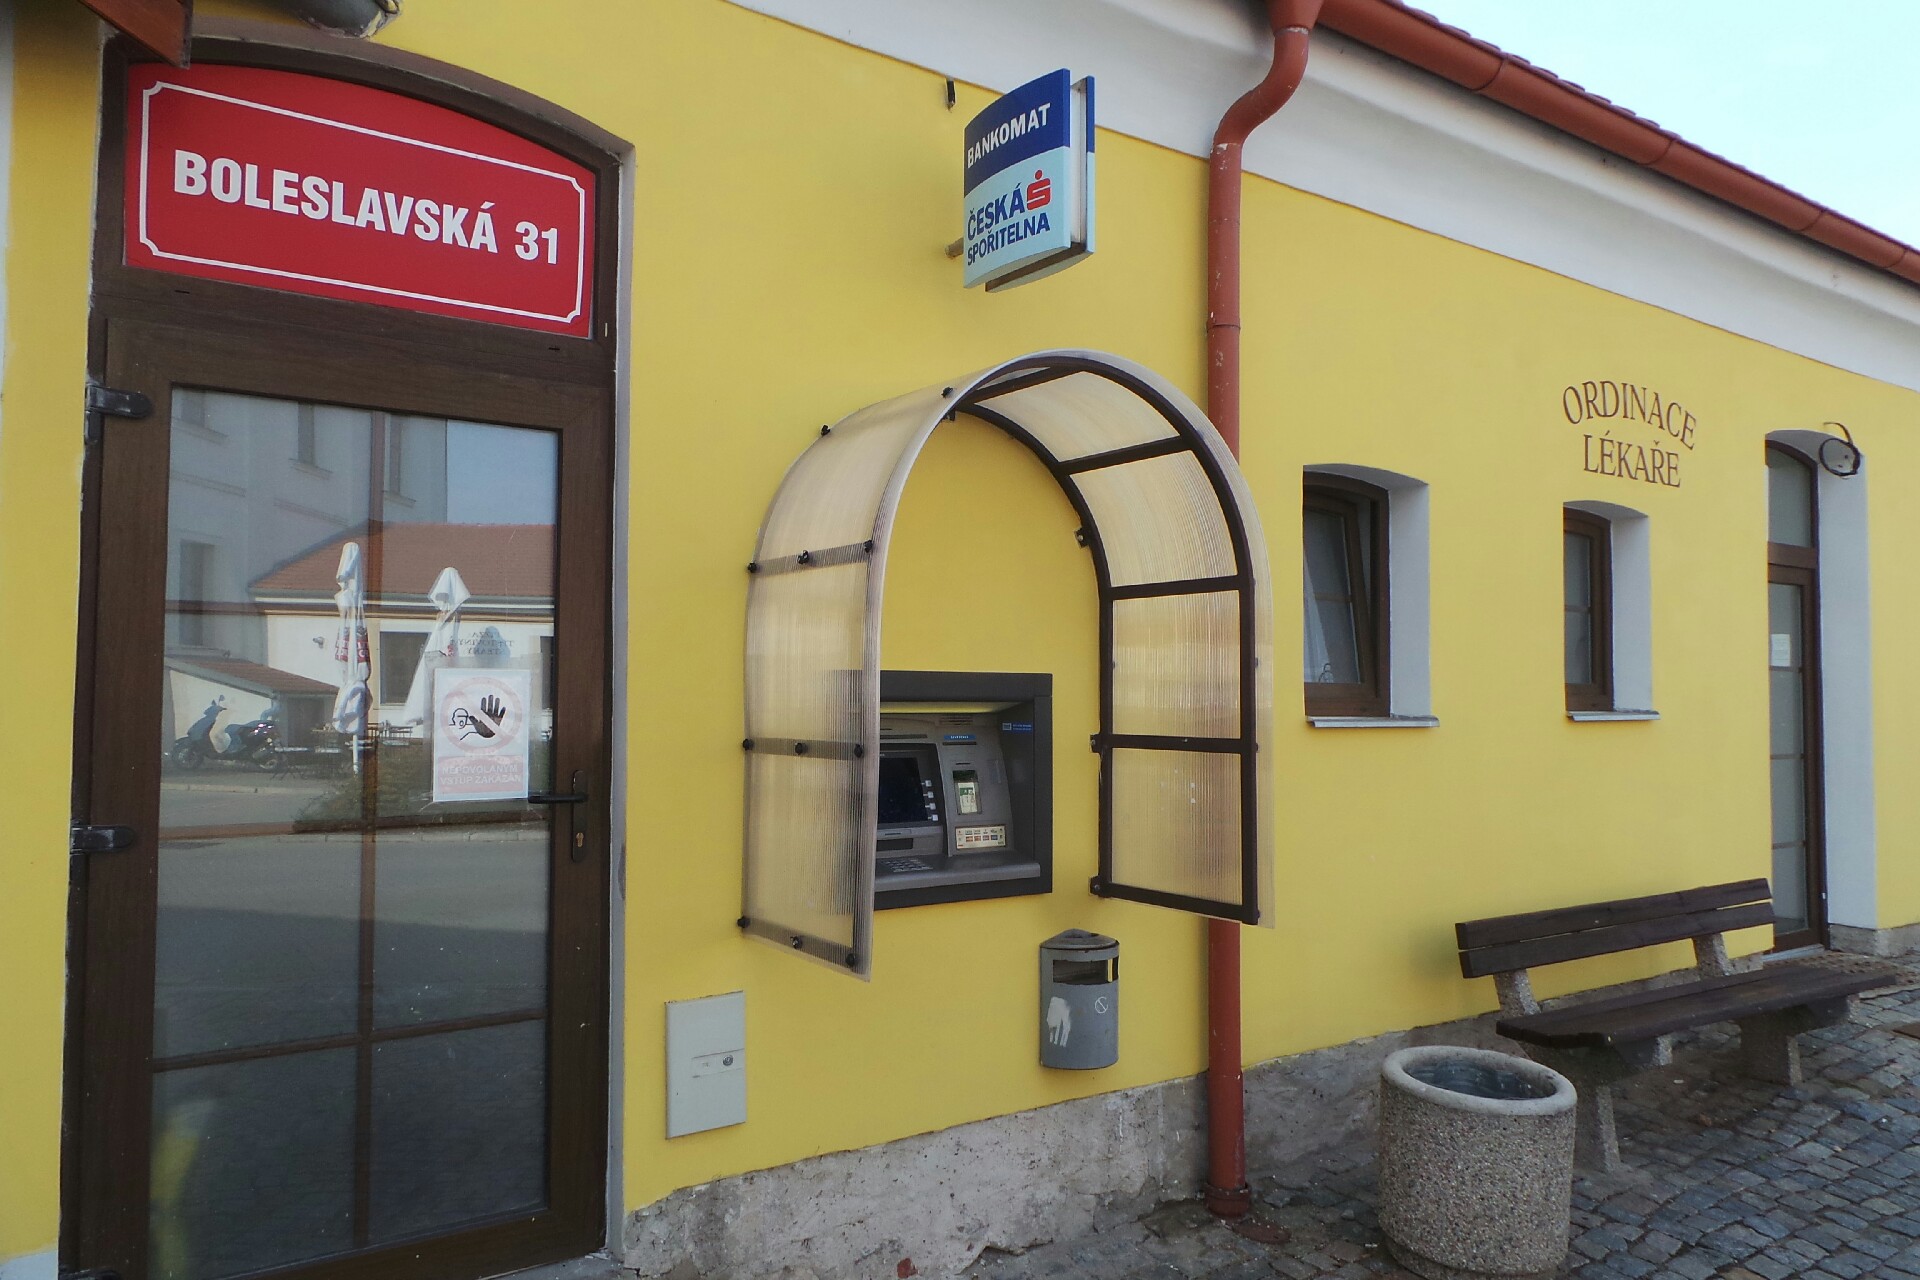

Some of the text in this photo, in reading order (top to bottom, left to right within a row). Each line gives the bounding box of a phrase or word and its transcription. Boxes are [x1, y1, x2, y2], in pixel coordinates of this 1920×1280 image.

[967, 102, 1051, 169] BANKOMAT
[174, 149, 559, 264] BOLESLAVSKÁ 31
[967, 182, 1026, 242] ČESKÁ
[967, 212, 1051, 266] SPOŘITELNA
[1562, 380, 1697, 451] ORDINACE
[1583, 429, 1681, 488] LÉKAŘE
[440, 776, 474, 785] VSTUP
